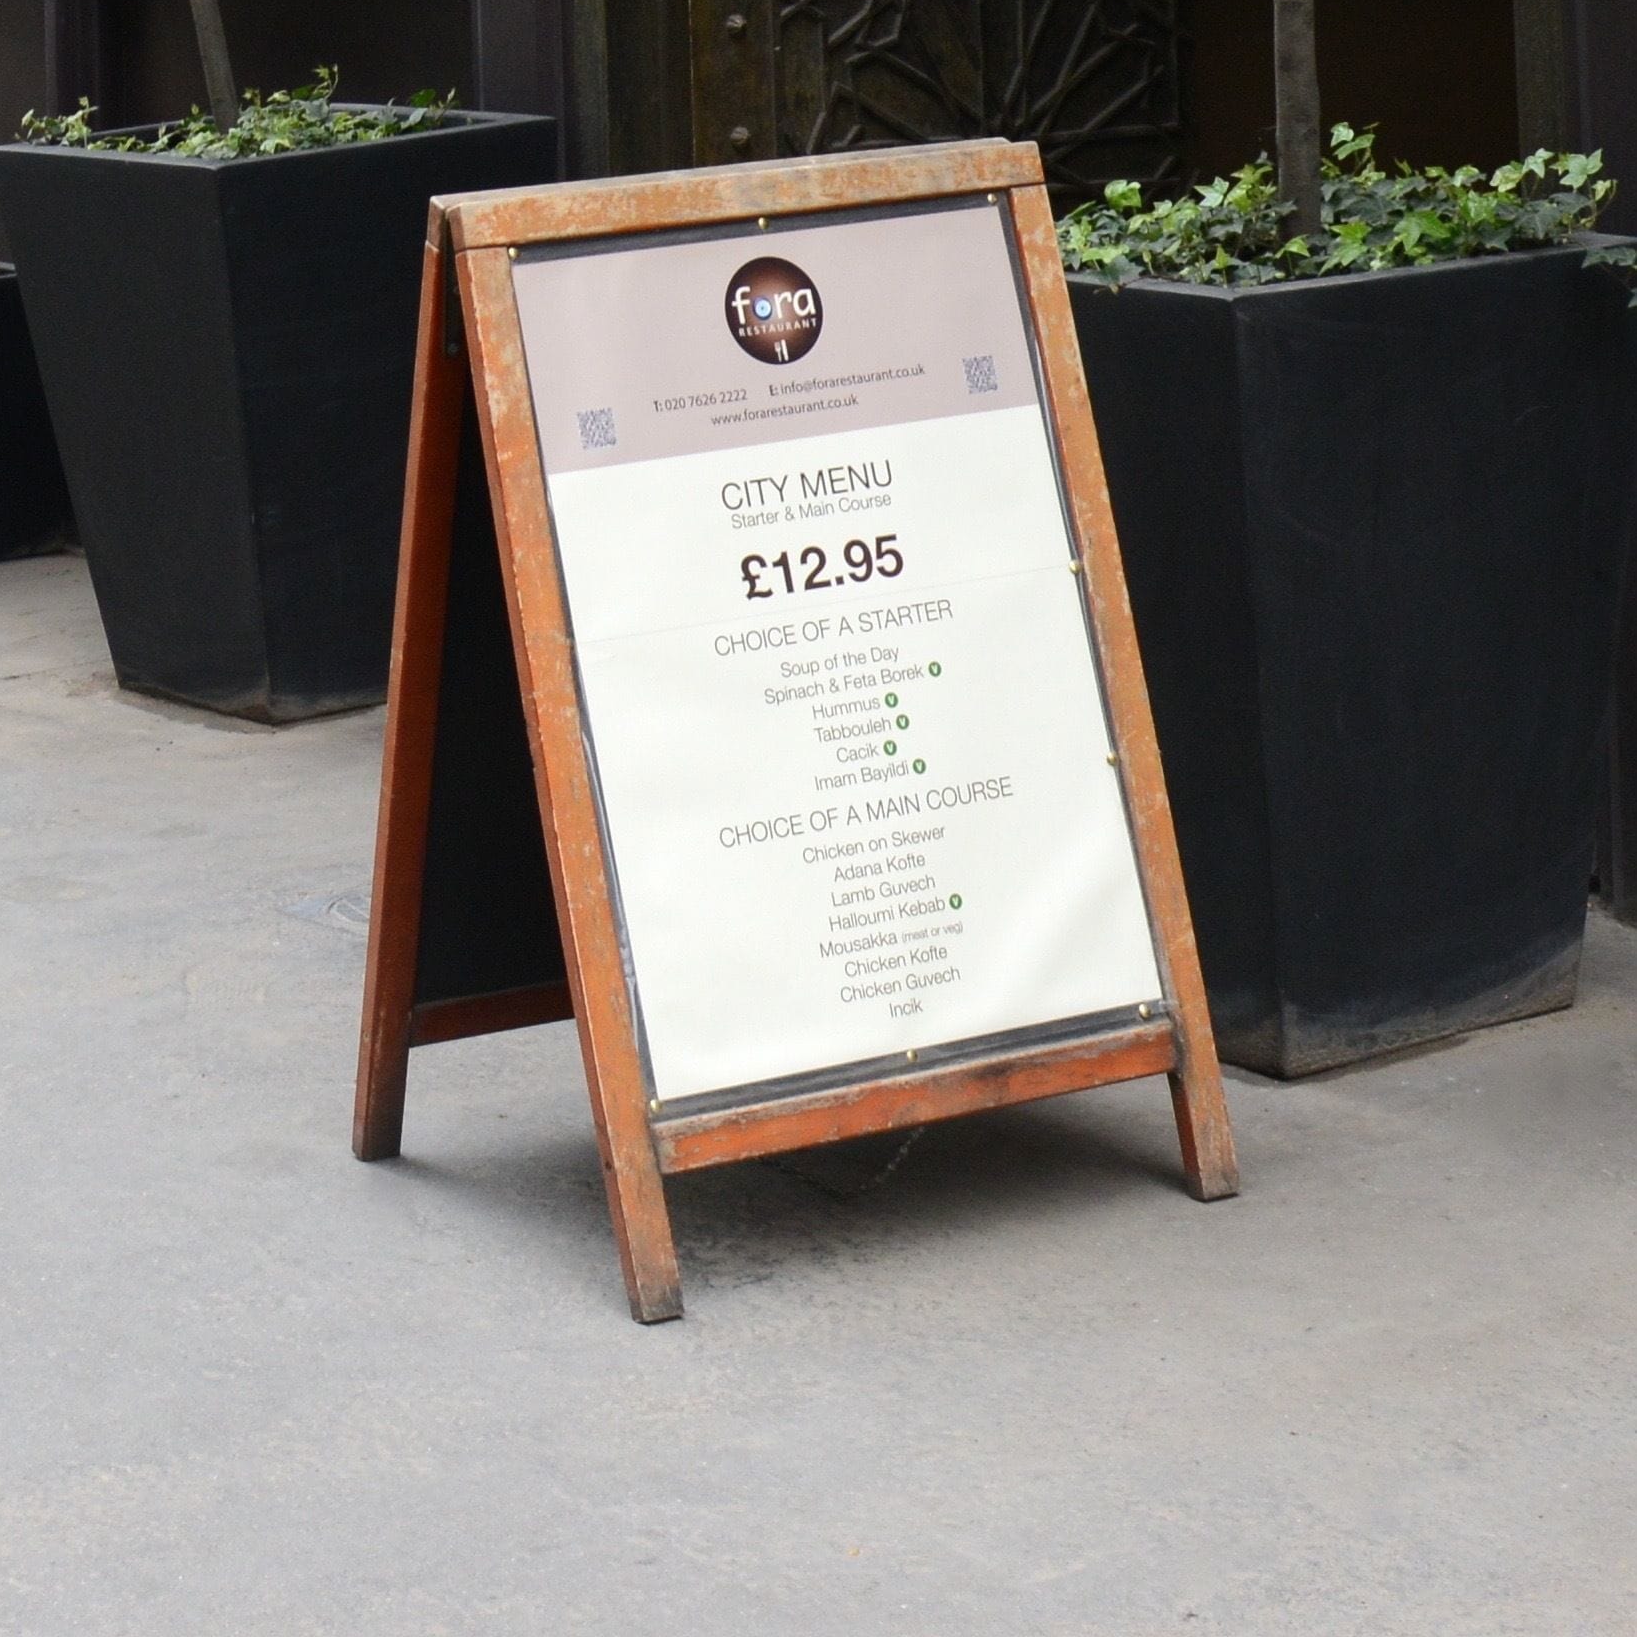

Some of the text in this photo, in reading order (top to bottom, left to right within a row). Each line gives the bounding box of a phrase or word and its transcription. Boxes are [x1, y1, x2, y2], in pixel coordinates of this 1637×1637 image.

[731, 286, 817, 325] fora
[738, 318, 818, 338] RESTAURANT
[664, 396, 686, 411] 020
[688, 392, 717, 408] 7626
[719, 389, 748, 405] 2222
[780, 364, 925, 396] info@forarestaurant.co.uk
[711, 394, 859, 426] www.forarestaurant.co.uk
[721, 459, 892, 510] CITY MENU
[731, 493, 891, 530] Starter & Main Course
[741, 534, 904, 600] £12.95
[714, 599, 954, 656] CHOICE OF A STARTER
[781, 646, 899, 678] Soup of the Day
[764, 681, 824, 705] Spinach
[829, 678, 840, 694] &
[843, 674, 877, 691] Feta
[880, 665, 924, 685] Borek
[812, 697, 881, 720] Hummus
[814, 718, 892, 743] Tabbouleh
[836, 743, 880, 763] Cacik
[815, 772, 857, 791] Imam
[861, 760, 910, 783] Bayildi
[719, 776, 1013, 848] CHOICE OF A MAIN COURSE
[803, 826, 945, 863] Chicken on Skewer
[834, 853, 926, 882] Adana Kofte
[831, 875, 936, 907] Lamb Guvech
[828, 906, 895, 932] Halloumi
[898, 897, 946, 919] Kebab
[819, 931, 898, 958] Mousakka
[844, 945, 948, 977] Chicken Kofte
[840, 967, 961, 1003] Chicken Guvech
[889, 999, 923, 1018] Incik
